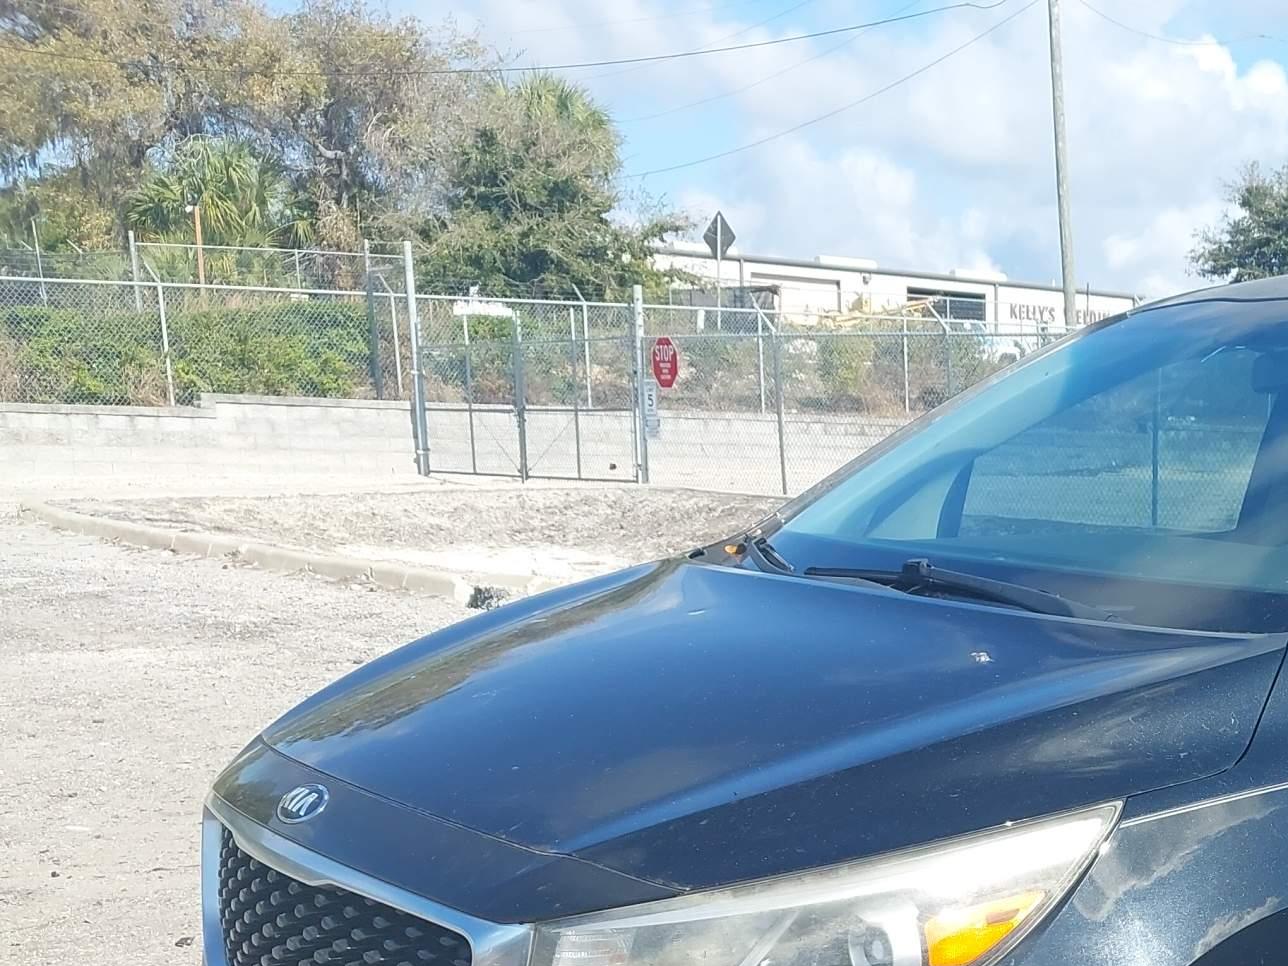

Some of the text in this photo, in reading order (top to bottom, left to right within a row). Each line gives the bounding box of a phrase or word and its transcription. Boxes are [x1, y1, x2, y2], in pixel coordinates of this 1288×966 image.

[1009, 303, 1056, 322] KELLY'S
[655, 344, 674, 361] STOP
[648, 393, 654, 407] 5
[281, 787, 319, 816] KIA
